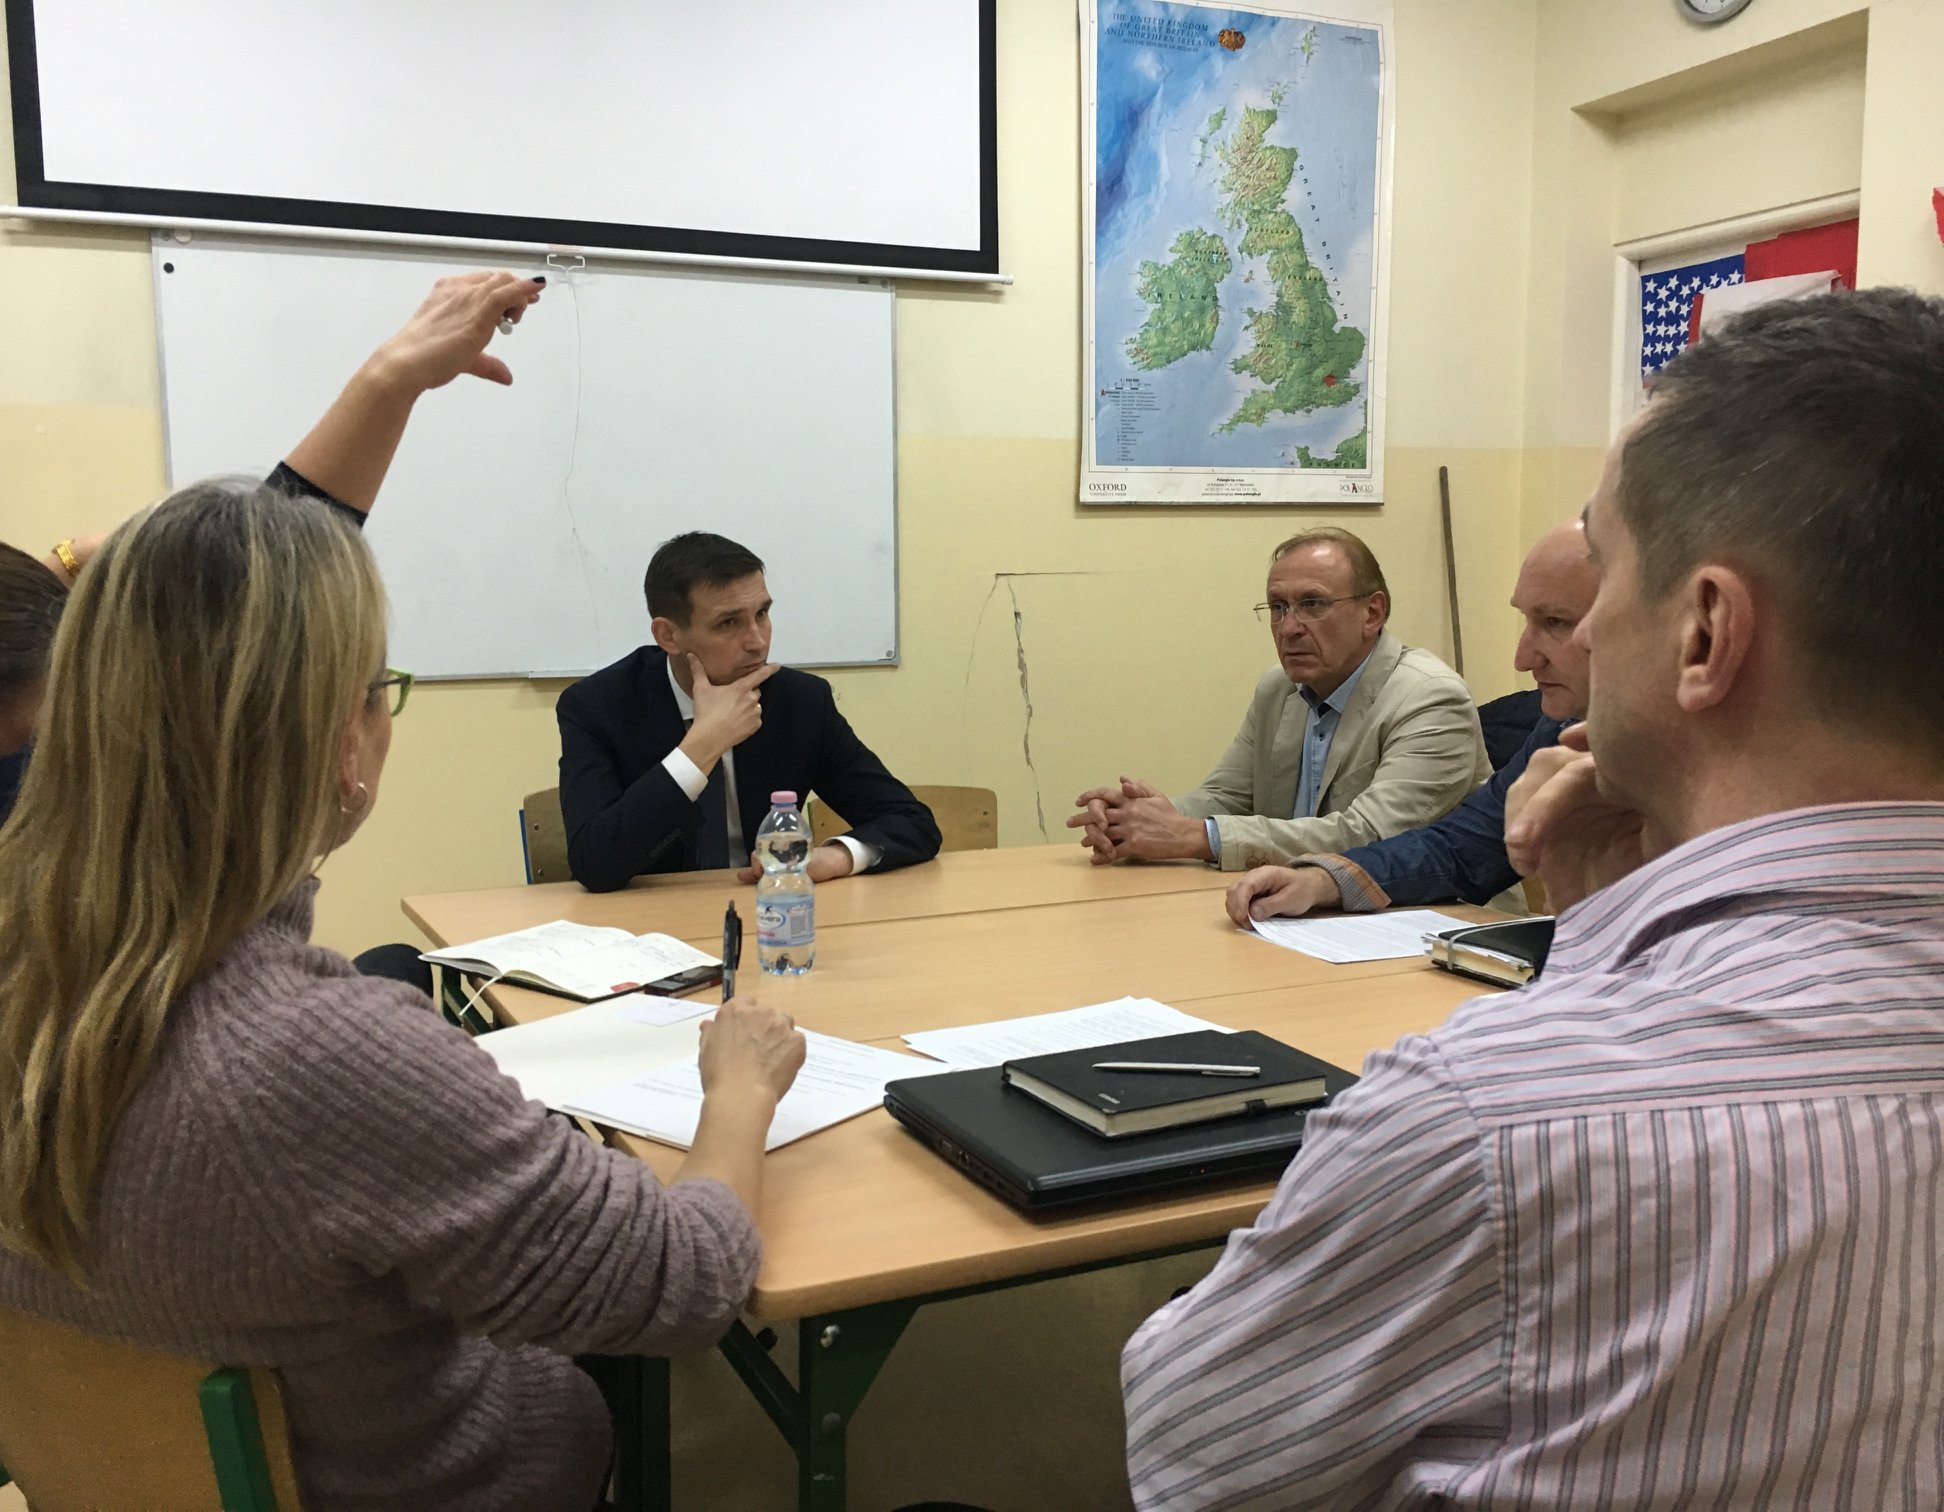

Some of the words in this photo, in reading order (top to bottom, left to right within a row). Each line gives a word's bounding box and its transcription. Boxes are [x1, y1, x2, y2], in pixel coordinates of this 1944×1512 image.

[1112, 13, 1126, 21] THE
[1130, 14, 1164, 25] UNITED
[1167, 19, 1209, 31] KINGDOM
[1104, 28, 1124, 36] AND
[1128, 30, 1176, 42] NORTHERN
[1177, 36, 1216, 48] IRELAND
[1134, 23, 1162, 33] GREAT
[1166, 27, 1200, 38] BRITAIN
[1088, 482, 1127, 491] OXFORD
